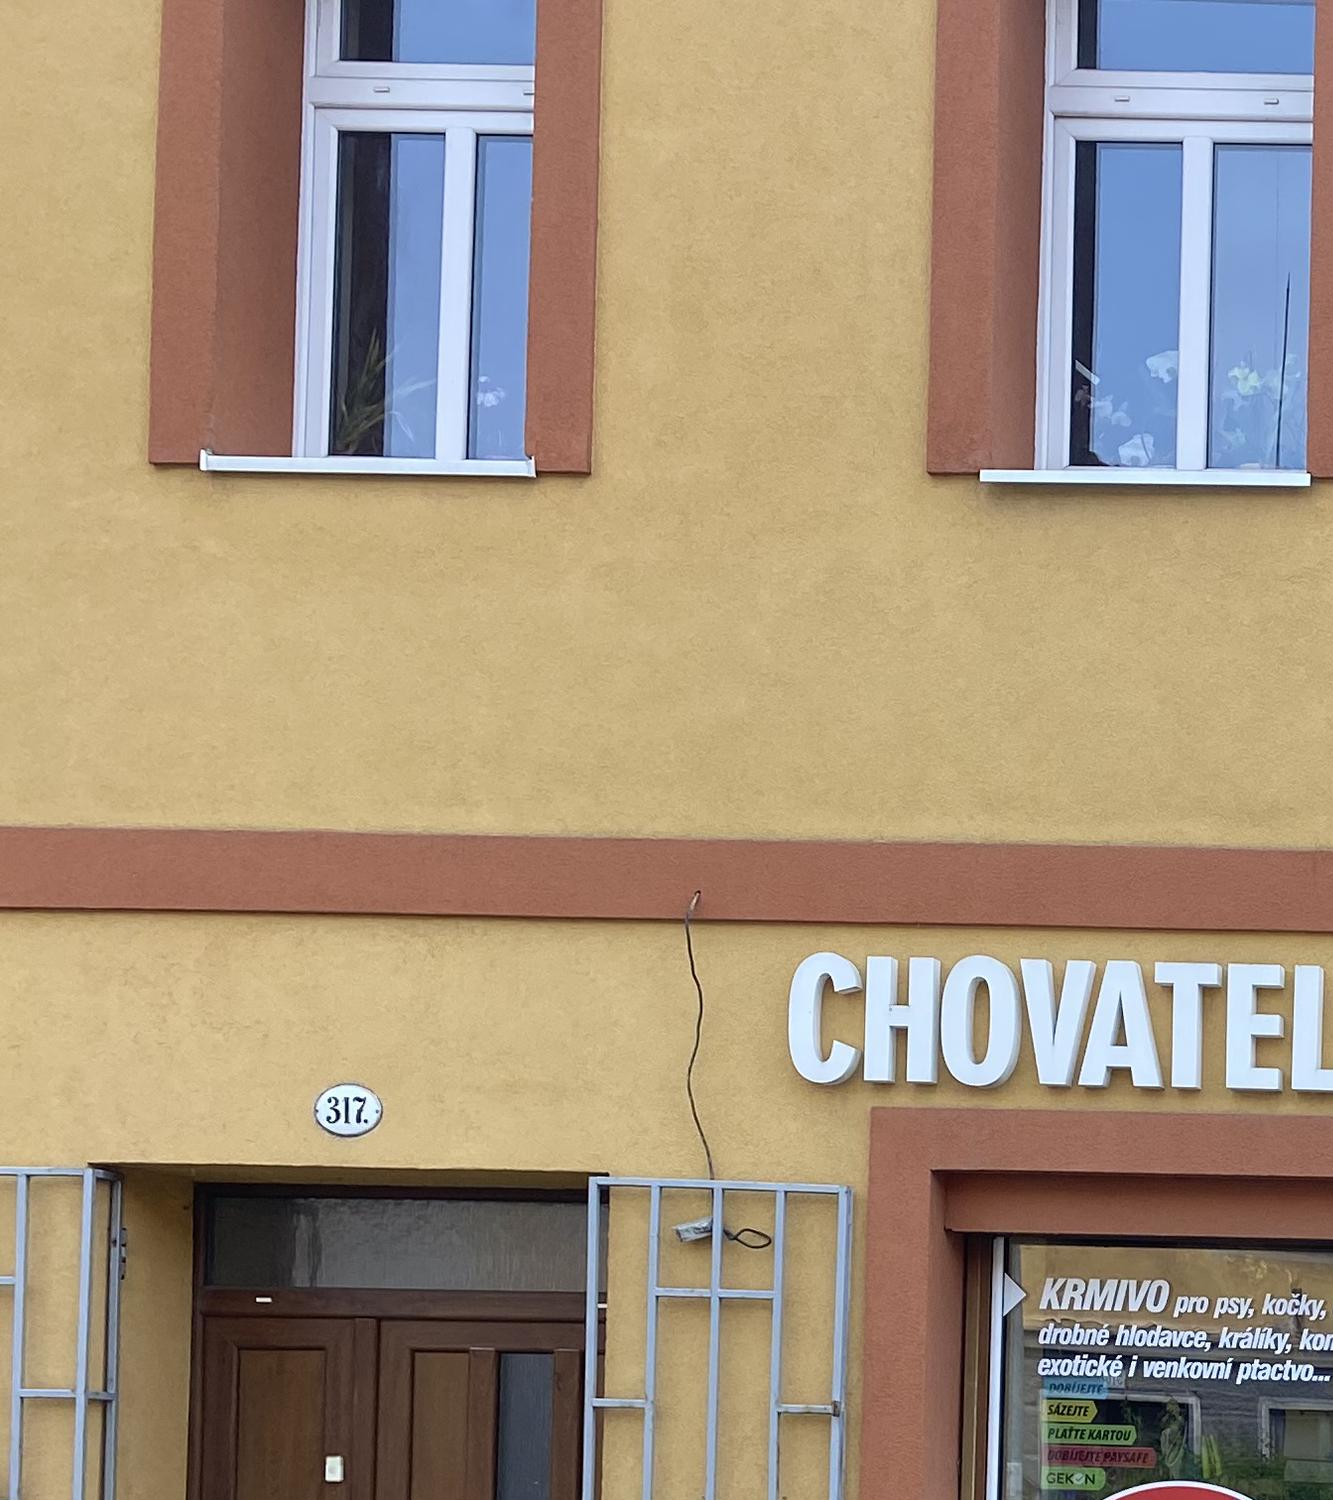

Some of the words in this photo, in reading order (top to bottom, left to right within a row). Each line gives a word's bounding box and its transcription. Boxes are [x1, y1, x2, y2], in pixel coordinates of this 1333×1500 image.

[1039, 1277, 1171, 1313] KRMIVO
[1173, 1296, 1208, 1316] pro
[1213, 1296, 1254, 1318] psy,
[1262, 1292, 1326, 1320] kočky,
[1038, 1323, 1110, 1346] drobné
[1115, 1325, 1211, 1352] hlodavce,
[1218, 1327, 1292, 1353] králíky,
[1037, 1353, 1123, 1378] exotické
[1128, 1355, 1136, 1377] i
[1143, 1356, 1232, 1381] venkovní
[1237, 1358, 1331, 1385] ptactvo...
[1047, 1402, 1090, 1417] SÁZEJTE
[1048, 1426, 1087, 1440] PLAŤTE
[1087, 1429, 1132, 1441] KARTOU
